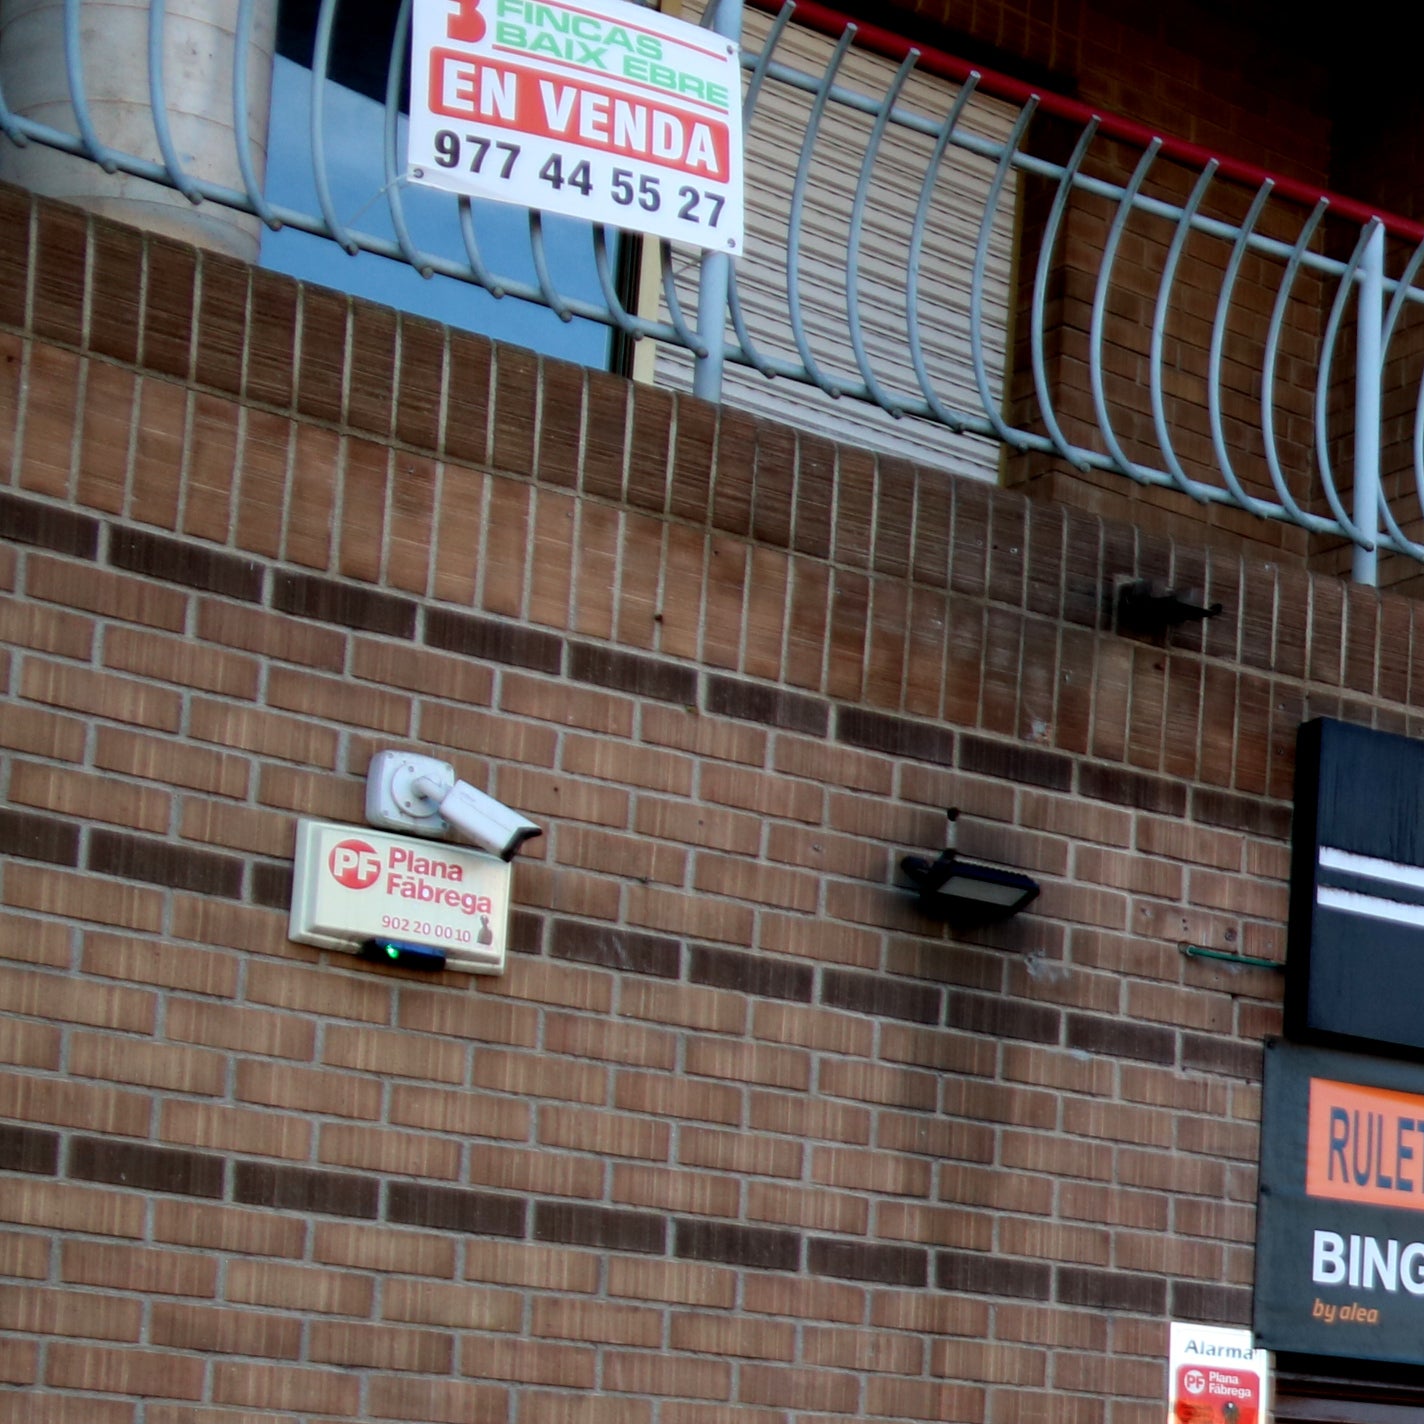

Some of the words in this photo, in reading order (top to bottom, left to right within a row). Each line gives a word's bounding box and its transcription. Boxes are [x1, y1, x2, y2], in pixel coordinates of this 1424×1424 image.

[495, 0, 664, 61] FINCAS
[496, 20, 609, 70] BAIX
[622, 54, 729, 108] EBRE
[442, 57, 518, 121] EN
[538, 78, 720, 174] VENDA
[433, 129, 521, 180] 977
[538, 152, 593, 196] 44
[610, 166, 662, 213] 55
[677, 184, 726, 229] 27
[388, 846, 463, 882] Plana
[382, 915, 410, 932] 902
[413, 921, 431, 936] 20
[434, 924, 453, 940] 00
[455, 929, 471, 943] 10
[1312, 1297, 1337, 1324] by
[1339, 1302, 1379, 1323] alea
[1184, 1338, 1255, 1361] Alarma
[1208, 1371, 1240, 1385] Plana
